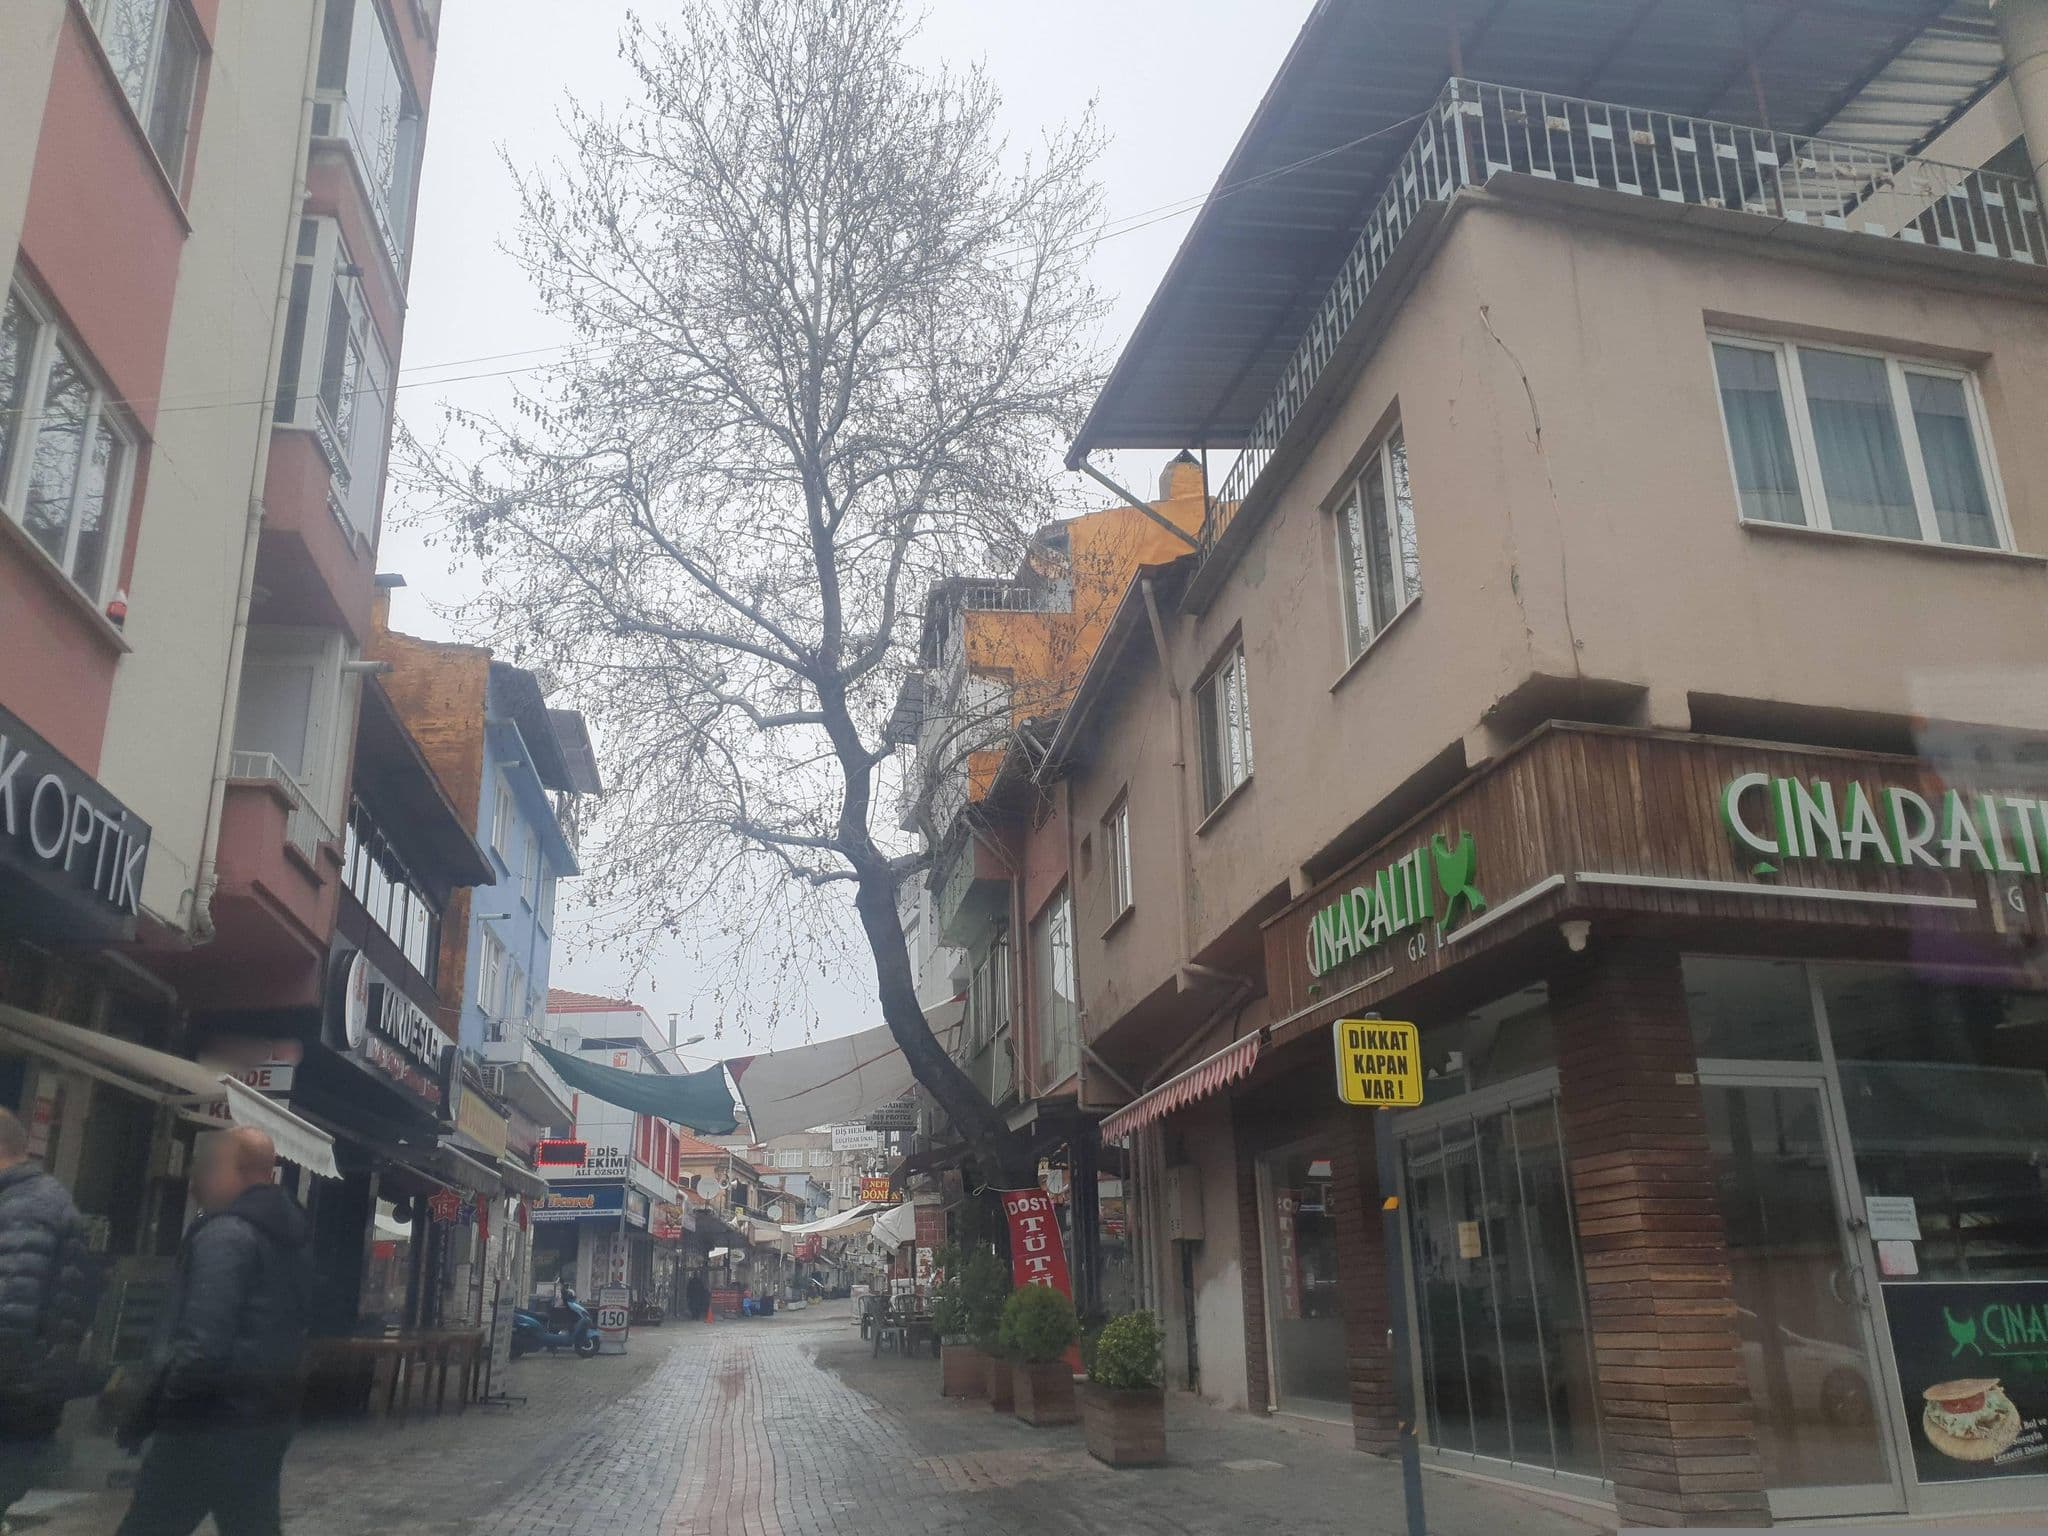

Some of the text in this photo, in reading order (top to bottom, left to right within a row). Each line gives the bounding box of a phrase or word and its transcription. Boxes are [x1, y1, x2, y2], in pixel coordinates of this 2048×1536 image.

[30, 773, 146, 917] OPTİK
[1348, 1026, 1408, 1051] DİKKAT
[1353, 1054, 1409, 1075] KAPAN
[575, 1167, 626, 1177] ALİ ÖZSOY
[1007, 1197, 1048, 1216] DOST
[600, 1310, 625, 1327] 150
